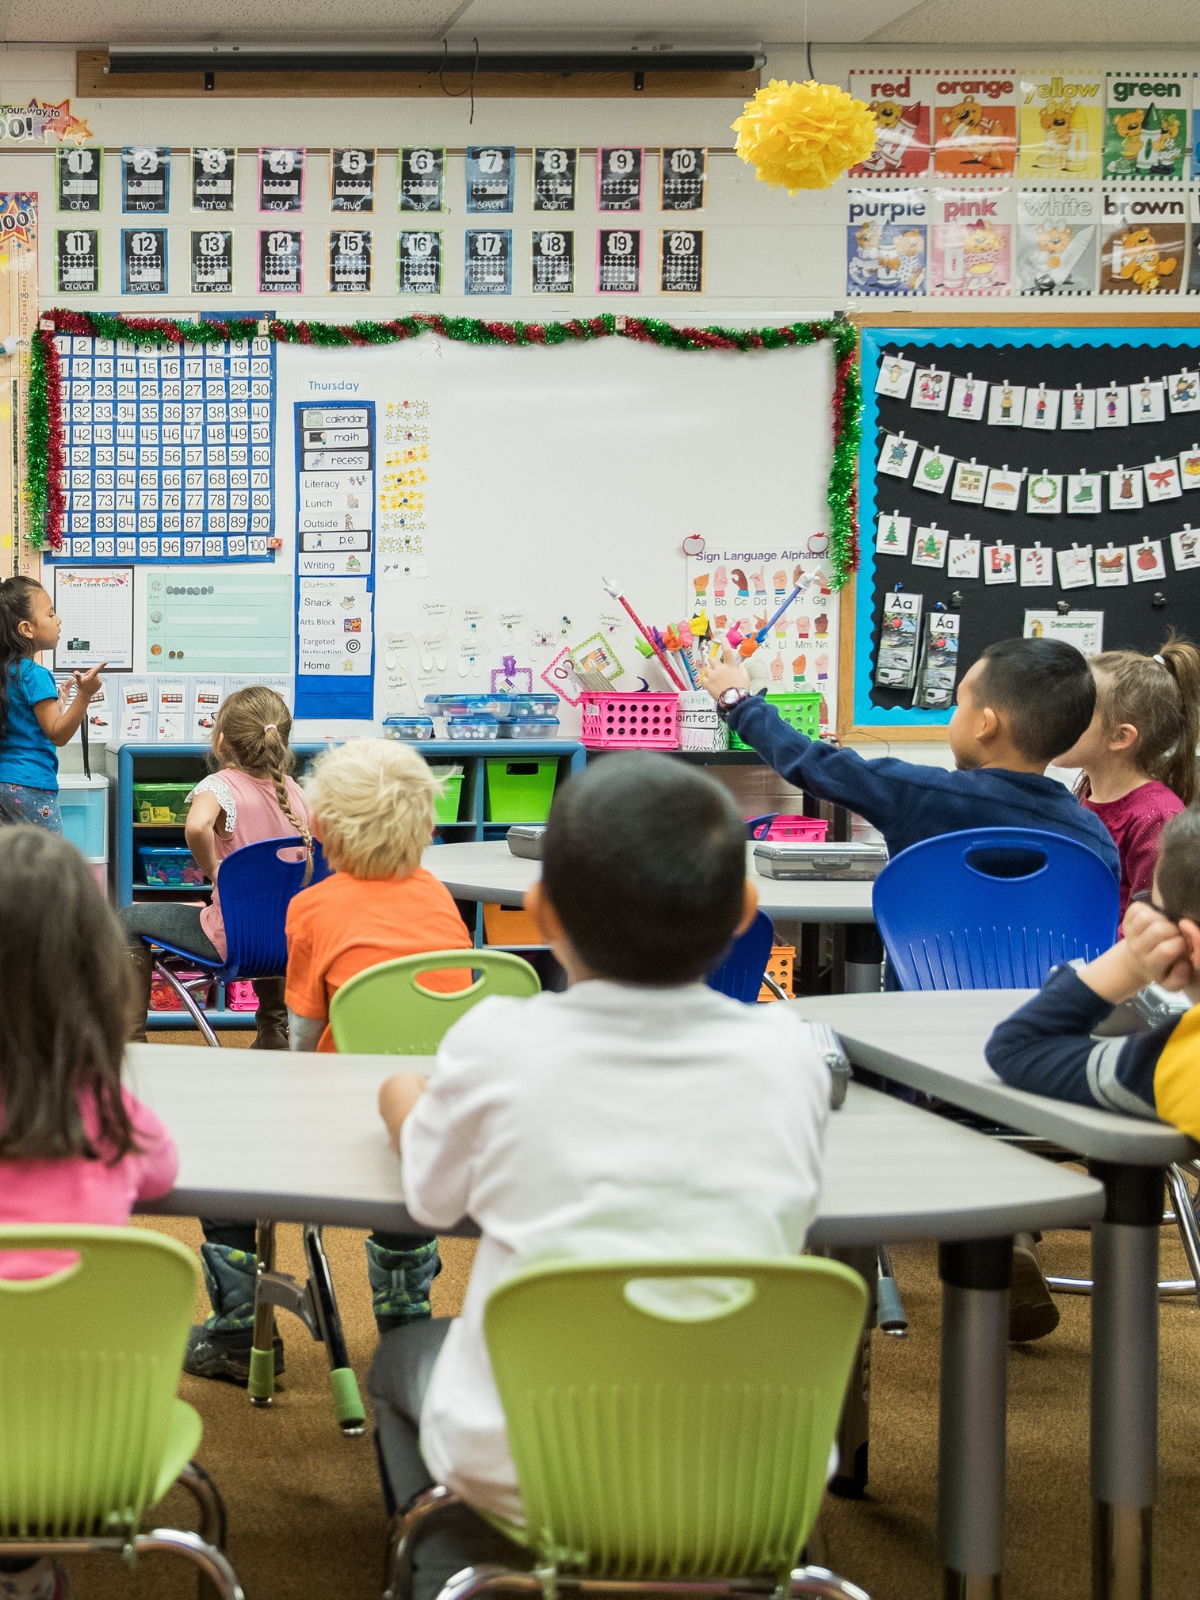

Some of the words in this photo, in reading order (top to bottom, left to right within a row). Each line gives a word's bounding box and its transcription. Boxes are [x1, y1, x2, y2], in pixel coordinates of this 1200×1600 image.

[871, 77, 910, 98] red
[936, 80, 1014, 98] orange
[1022, 78, 1100, 104] yellow
[1114, 81, 1181, 102] green
[27, 108, 48, 118] way
[50, 109, 60, 118] to
[76, 154, 83, 169] 1
[140, 154, 150, 170] 2
[210, 154, 220, 170] 3
[276, 153, 287, 170] 4
[350, 154, 360, 170] 5
[416, 154, 427, 170] 6
[486, 154, 497, 170] 7
[550, 154, 560, 170] 8
[617, 154, 627, 170] 9
[677, 154, 690, 169] 10
[70, 200, 90, 210] one
[136, 201, 154, 210] two
[201, 200, 226, 210] three
[270, 201, 292, 210] four
[343, 202, 362, 210] five
[477, 200, 504, 210] seven
[542, 200, 568, 210] eight
[674, 201, 692, 210] ten
[850, 199, 926, 222] purple
[944, 198, 998, 222] pink
[1023, 194, 1092, 216] white
[1104, 196, 1184, 216] brown
[74, 235, 84, 251] 11
[138, 236, 153, 252] 12
[204, 237, 220, 252] 13
[274, 236, 288, 252] 14
[344, 236, 358, 251] 15
[413, 237, 427, 252] 16
[482, 237, 496, 252] 17
[546, 236, 561, 252] 18
[614, 236, 627, 251] 19
[674, 236, 692, 251] 20
[64, 282, 94, 290] eleven
[130, 283, 160, 292] twelve
[404, 284, 434, 292] sixteen
[470, 284, 508, 292] seventeen
[666, 284, 696, 292] twenty
[74, 385, 90, 396] 22
[96, 385, 112, 396] 23
[119, 385, 135, 396] 24
[142, 385, 157, 396] 25
[164, 385, 180, 396] 26
[185, 385, 201, 396] 27
[208, 385, 224, 396] 28
[231, 384, 246, 396] 29
[253, 384, 268, 396] 30
[308, 381, 360, 392] Thursday
[326, 415, 364, 424] calendar
[334, 432, 360, 442] math
[331, 456, 364, 465] recess
[304, 480, 340, 490] Literacy
[305, 499, 332, 508] Lunch
[304, 520, 338, 528] Outside
[74, 541, 90, 552] 92
[97, 541, 113, 552] 93
[118, 541, 134, 552] 94
[141, 541, 156, 552] 95
[163, 541, 179, 552] 96
[186, 541, 201, 552] 97
[206, 540, 222, 552] 98
[229, 540, 245, 552] 99
[250, 540, 266, 551] 100
[339, 536, 356, 546] p.e.
[696, 551, 720, 562] Sign
[724, 551, 778, 562] Language
[780, 550, 829, 562] Alphabet
[304, 561, 335, 572] Writing
[304, 580, 338, 588] Outside
[304, 598, 332, 607] Snack
[694, 598, 707, 606] Aa
[714, 598, 727, 606] Bb
[734, 598, 747, 606] Cc
[754, 598, 766, 606] Dd
[812, 596, 826, 606] Gg
[892, 596, 913, 610] Aa
[936, 616, 954, 630] Aa
[1050, 620, 1096, 629] December
[303, 638, 336, 646] Targeted
[795, 641, 812, 649] Mm
[816, 641, 828, 649] Nn
[304, 661, 330, 670] Home
[676, 712, 716, 722] ointers
